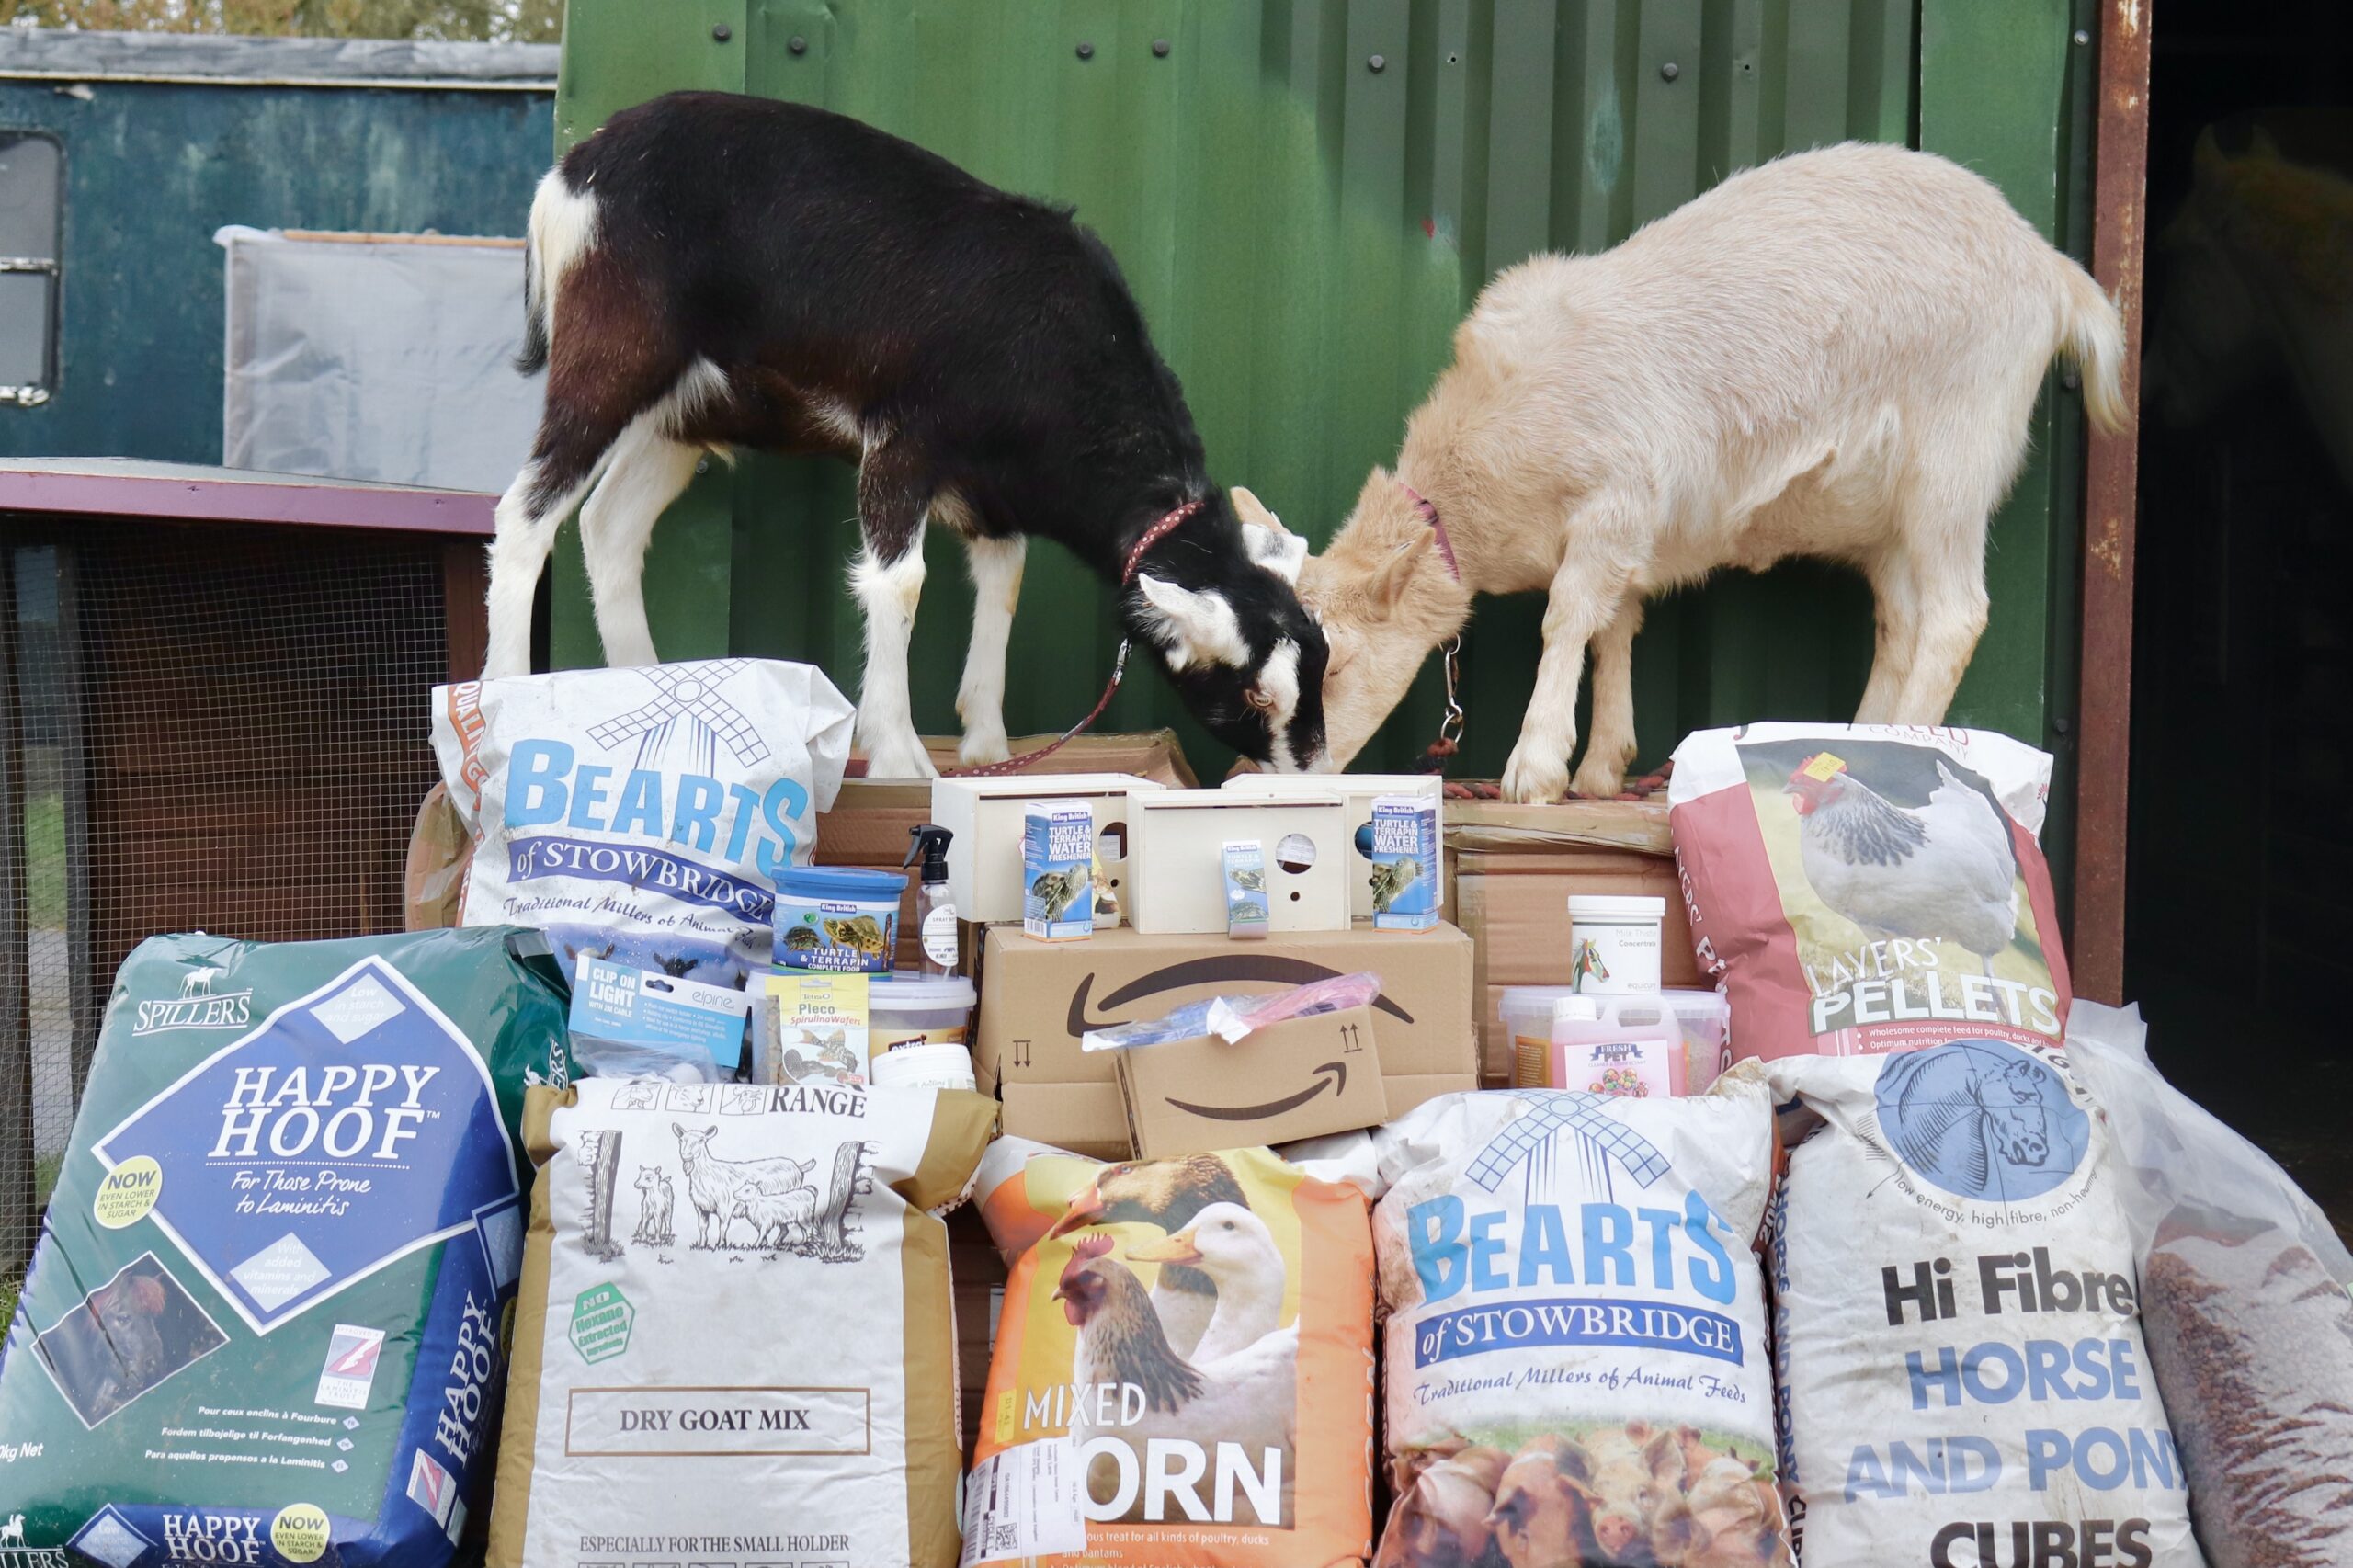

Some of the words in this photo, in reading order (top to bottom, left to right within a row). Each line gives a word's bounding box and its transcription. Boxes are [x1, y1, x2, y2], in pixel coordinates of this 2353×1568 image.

[505, 738, 808, 879] BEARTS
[1052, 814, 1067, 823] King
[1068, 812, 1087, 821] British
[1378, 806, 1392, 814] King
[1049, 824, 1083, 835] TURTLE
[1085, 824, 1091, 834] &
[1374, 819, 1409, 827] TURTLE
[1410, 820, 1418, 828] &
[1374, 826, 1418, 836] TERRAPIN
[1049, 833, 1092, 844] TERRAPIN
[1049, 841, 1092, 855] WATER
[1374, 835, 1418, 846] WATER
[1048, 852, 1092, 862] FRESHENER
[1374, 846, 1419, 854] FRESHENER
[517, 841, 542, 881] of
[503, 896, 591, 917] Traditional
[591, 893, 652, 925] Millers
[821, 903, 835, 913] King
[836, 904, 857, 913] British
[800, 954, 808, 962] &
[811, 955, 869, 967] TERRAPIN
[813, 948, 858, 958] TURTLE
[807, 962, 842, 971] COMPLETE
[1807, 937, 1942, 999] LAYERS'
[592, 967, 618, 983] CLIP
[620, 975, 636, 990] ON
[350, 987, 379, 998] Low
[589, 981, 636, 1008] LIGHT
[691, 989, 734, 1009] elpine
[348, 997, 384, 1010] starch
[588, 1000, 604, 1011] WITH
[614, 1006, 632, 1017] CABLE
[799, 1003, 835, 1015] Pleco
[1813, 970, 2063, 1036] PELLETS
[132, 995, 251, 1032] SPILLERS
[1869, 1026, 1915, 1038] Wholesome
[1916, 1026, 1952, 1037] complete
[1953, 1025, 1971, 1035] feed
[1972, 1026, 1984, 1036] for
[1984, 1028, 2012, 1040] poultry,
[2012, 1032, 2030, 1043] ducks
[1870, 1040, 1907, 1050] Optimum
[1908, 1038, 1943, 1048] nutrition
[1600, 1044, 1632, 1053] FRESH
[1604, 1051, 1629, 1062] PET
[223, 1064, 440, 1108] HAPPY
[769, 1086, 867, 1119] RANGE
[207, 1106, 426, 1160] HOOF
[108, 1170, 157, 1190] NOW
[231, 1170, 260, 1190] For
[263, 1169, 312, 1191] Those
[314, 1170, 372, 1193] Prone
[98, 1203, 108, 1211] IN
[109, 1199, 142, 1210] STARCH
[143, 1199, 151, 1207] &
[100, 1192, 123, 1202] EVEN
[125, 1189, 155, 1199] LOWER
[235, 1193, 256, 1214] to
[256, 1193, 350, 1216] Laminitis
[1893, 1174, 1914, 1197] low
[1916, 1194, 1966, 1225] energy,
[1972, 1210, 2004, 1229] high
[2009, 1210, 2048, 1224] fibre,
[107, 1209, 137, 1219] SUGAR
[1774, 1184, 1790, 1292] HORSE
[278, 1243, 303, 1254] With
[1407, 1190, 1737, 1309] BEARTS
[264, 1256, 302, 1268] added
[244, 1269, 290, 1281] vitamins
[293, 1271, 317, 1282] and
[250, 1283, 299, 1295] minerals
[1881, 1256, 1957, 1326] Hi
[1977, 1246, 2133, 1316] Fibre
[582, 1290, 610, 1311] NO
[574, 1305, 624, 1334] Hexane
[336, 1326, 372, 1337] APPROVED
[577, 1319, 628, 1347] Extracted
[1422, 1320, 1448, 1363] of
[1454, 1305, 1734, 1354] STOWBRIDGE
[1777, 1309, 1791, 1378] AND
[435, 1290, 483, 1455] HAPPY
[1904, 1338, 2141, 1410] HORSE
[449, 1307, 496, 1471] HOOF
[1413, 1368, 1513, 1407] Traditional
[1516, 1367, 1592, 1390] Millers
[1598, 1368, 1620, 1390] of
[1622, 1367, 1693, 1391] Animal
[1699, 1374, 1746, 1403] Feeds
[198, 1406, 221, 1416] Pour
[222, 1408, 244, 1417] ceux
[246, 1407, 279, 1419] enclins
[290, 1412, 337, 1425] Fourbure
[1022, 1381, 1147, 1432] MIXED
[620, 1409, 673, 1431] DRY
[679, 1409, 752, 1431] GOAT
[758, 1409, 811, 1431] MIX
[161, 1427, 197, 1437] Fordem
[249, 1431, 259, 1440] til
[261, 1432, 332, 1447] Forfangenhed
[1778, 1385, 1800, 1483] PONY
[20, 1442, 44, 1458] Net
[145, 1449, 166, 1460] Para
[167, 1450, 207, 1461] aquellos
[208, 1453, 258, 1464] propensos
[261, 1456, 267, 1464] a
[269, 1454, 278, 1464] la
[280, 1456, 325, 1469] Laminitis
[1844, 1435, 2003, 1505] AND
[1082, 1435, 1282, 1527] ORN
[163, 1514, 261, 1540] HAPPY
[279, 1516, 324, 1531] NOW
[297, 1532, 324, 1540] LOWER
[579, 1536, 665, 1552] ESPECIALLY
[669, 1537, 699, 1552] FOR
[700, 1537, 731, 1552] THE
[733, 1536, 784, 1552] SMALL
[787, 1535, 850, 1551] HOLDER
[1106, 1532, 1130, 1542] treat
[1131, 1531, 1145, 1542] for
[1146, 1532, 1159, 1542] all
[1161, 1530, 1187, 1543] kinds
[1188, 1531, 1200, 1542] of
[1200, 1532, 1238, 1546] poultry,
[1241, 1533, 1269, 1545] ducks
[1930, 1518, 2153, 1568] CUBES
[165, 1536, 260, 1564] HOOF
